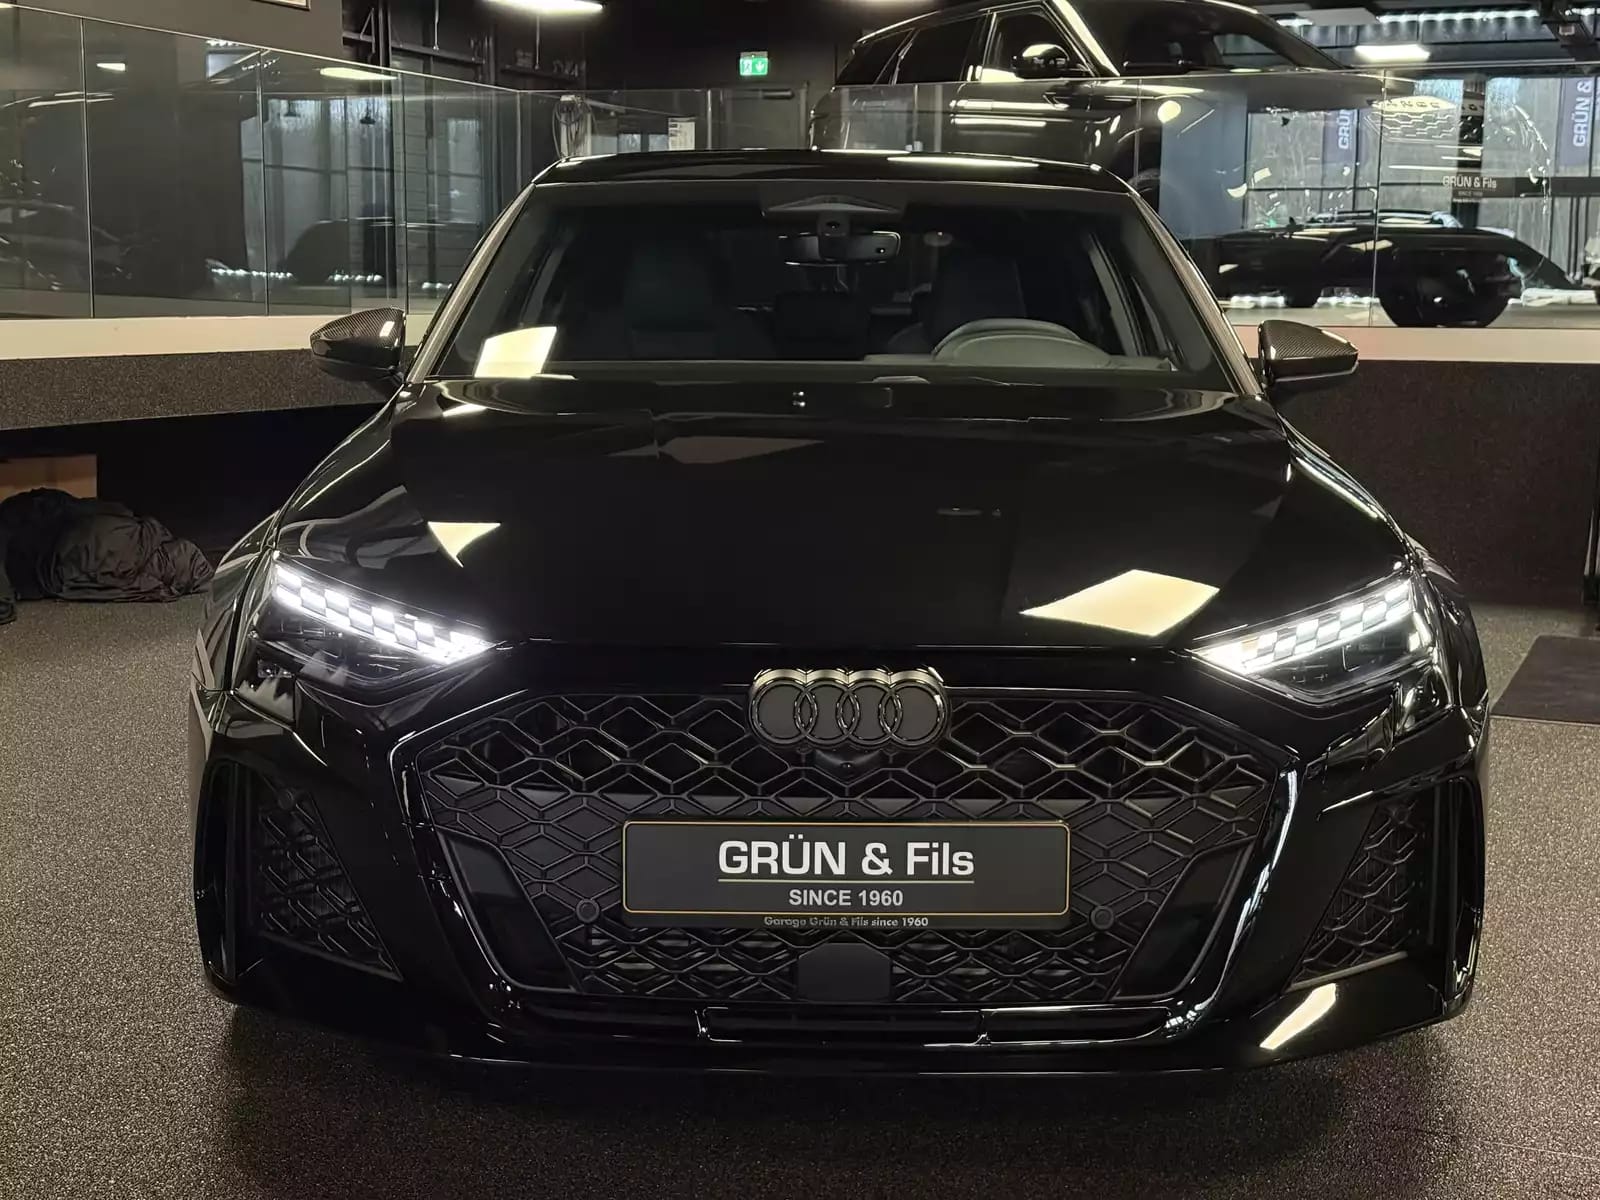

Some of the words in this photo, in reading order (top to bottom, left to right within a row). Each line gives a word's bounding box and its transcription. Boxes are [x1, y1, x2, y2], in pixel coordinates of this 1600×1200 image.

[1576, 80, 1593, 94] &
[1571, 96, 1591, 147] GRÜN
[1442, 174, 1472, 188] GRÜN
[1473, 176, 1481, 188] &
[1482, 176, 1497, 189] Fils
[718, 834, 846, 875] GRÜN
[861, 842, 893, 876] &
[906, 842, 975, 876] Fils
[788, 889, 852, 906] SINCE
[858, 889, 904, 907] 1960
[763, 916, 807, 928] Garage
[809, 916, 837, 927] Grün
[839, 917, 849, 927] &
[851, 917, 869, 927] Fils
[871, 917, 899, 927] since
[902, 917, 929, 928] 1960
